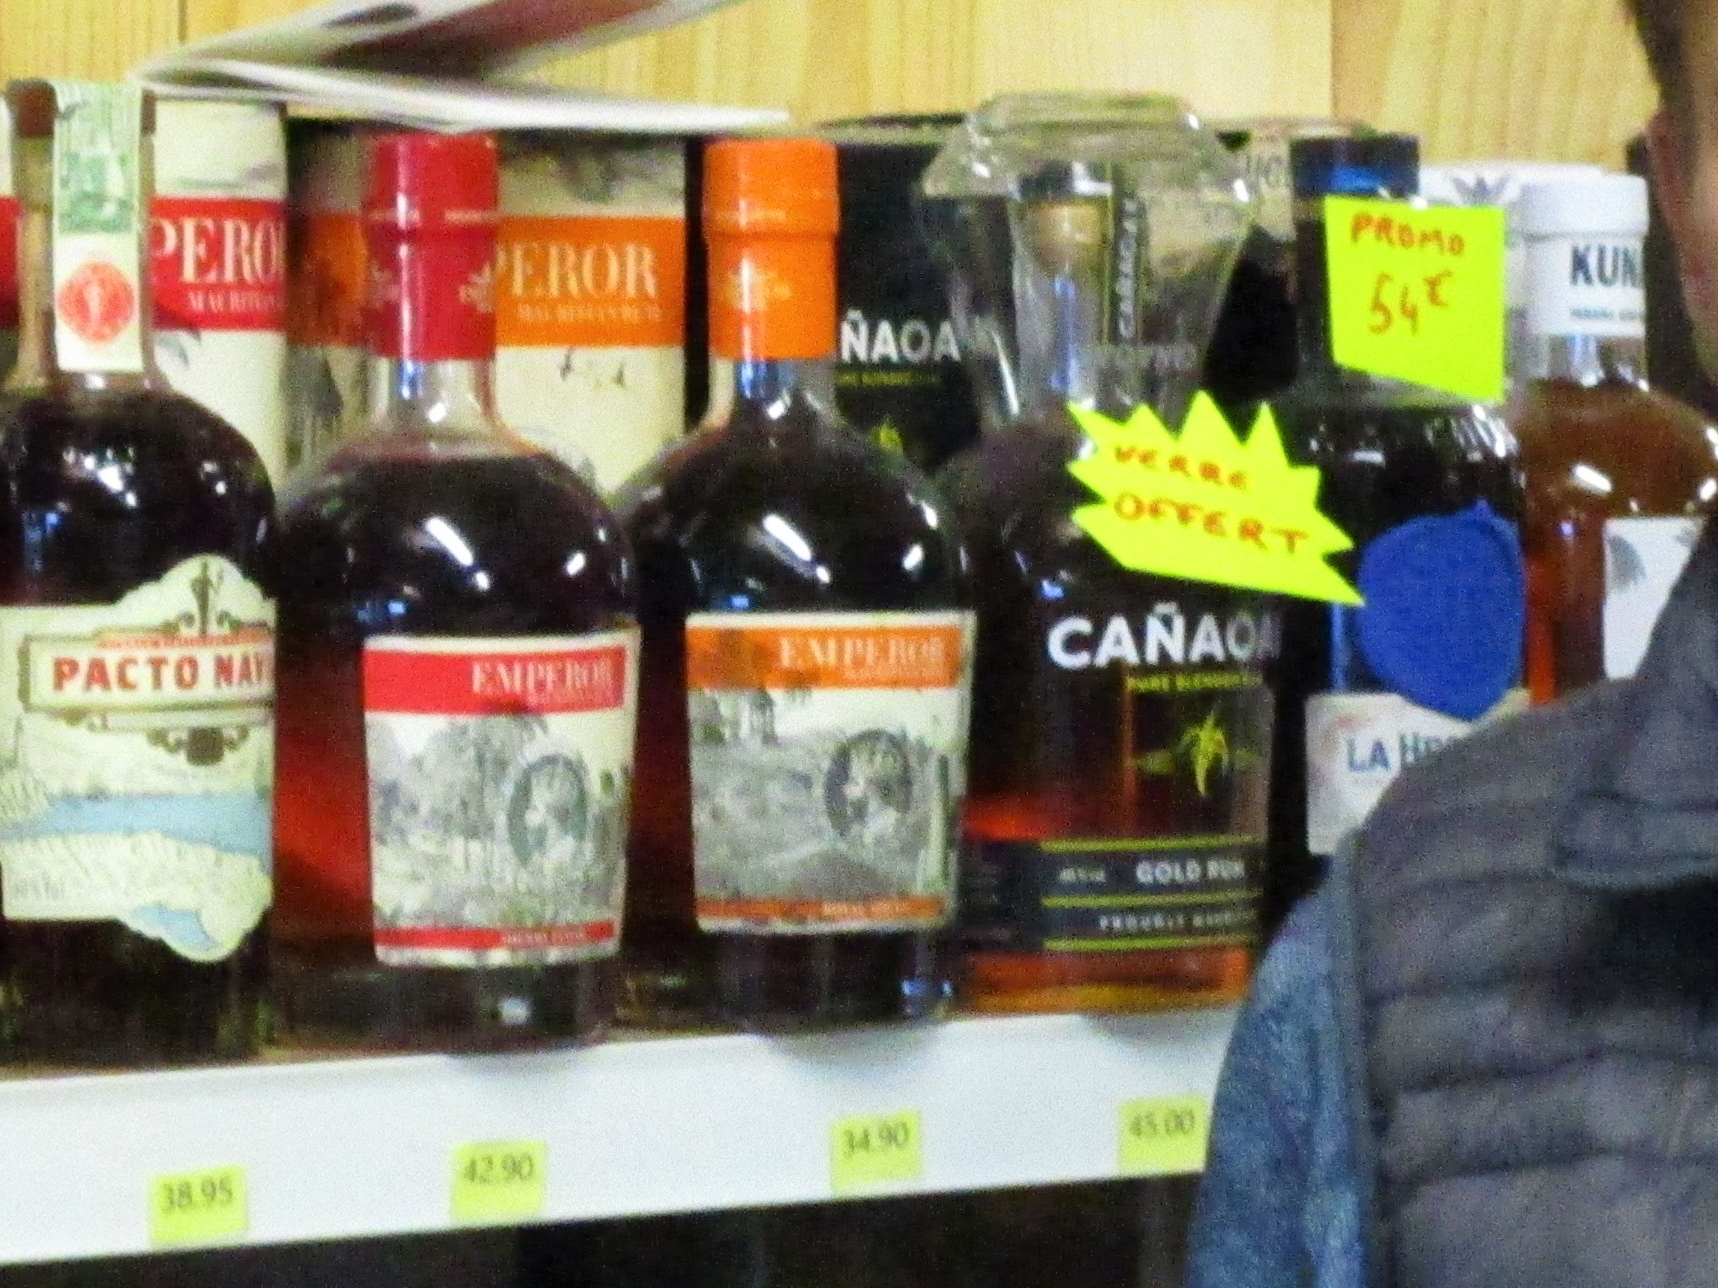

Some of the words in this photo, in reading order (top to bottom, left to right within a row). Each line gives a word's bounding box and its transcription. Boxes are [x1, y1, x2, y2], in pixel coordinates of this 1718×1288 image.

[1349, 211, 1467, 259] PROMO
[839, 308, 962, 365] ÑAOA
[1112, 494, 1312, 559] OFFERT
[52, 655, 201, 696] PACTO
[1136, 860, 1202, 885] GOLD
